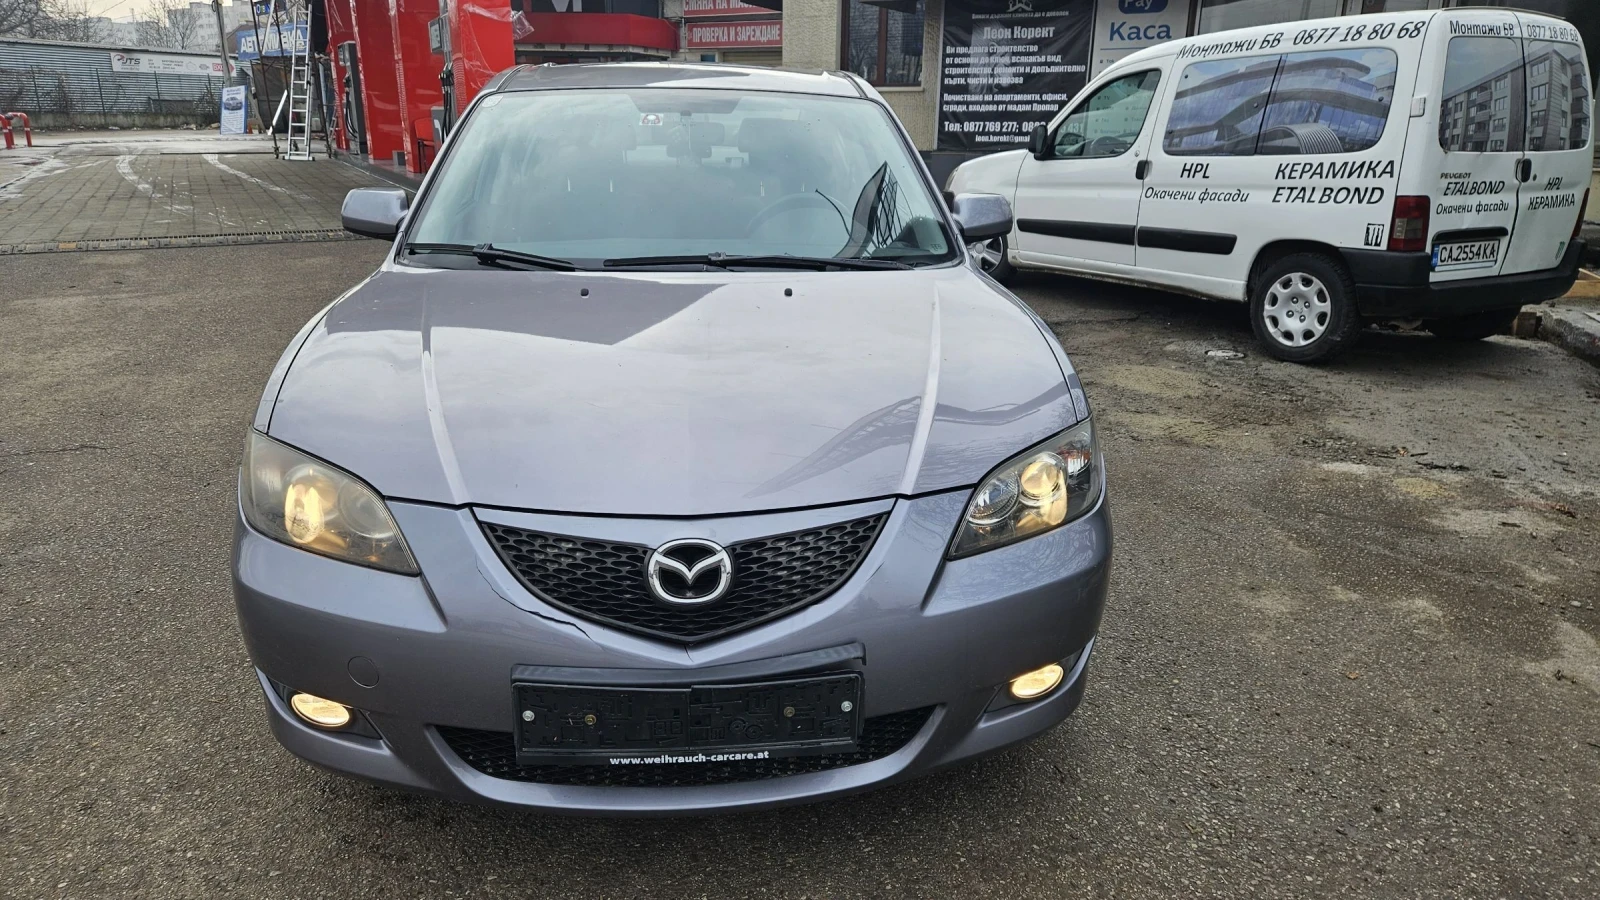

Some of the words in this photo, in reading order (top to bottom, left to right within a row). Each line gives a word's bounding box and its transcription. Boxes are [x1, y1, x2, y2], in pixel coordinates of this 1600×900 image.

[684, 0, 714, 11] СМЯНА
[692, 26, 728, 43] ПРОВЕРКА
[730, 27, 735, 42] И
[737, 25, 780, 42] ЗАРЕЖДАНЕ
[983, 26, 1012, 39] Леон
[1014, 26, 1055, 39] Корект
[1109, 21, 1172, 41] Каса
[1450, 20, 1500, 36] Монтажи
[1503, 22, 1514, 36] БВ
[1526, 24, 1546, 39] 0877
[1548, 26, 1558, 40] 18
[1559, 28, 1569, 41] 80
[1569, 29, 1579, 42] 68
[1177, 38, 1258, 60] Монтажи
[1259, 32, 1285, 49] БВ
[1292, 26, 1341, 46] 0877
[1339, 24, 1367, 43] 18
[1367, 22, 1396, 41] 80
[1397, 20, 1426, 39] 68
[946, 46, 955, 54] Ви
[956, 46, 988, 54] предлага
[990, 45, 1038, 53] строителство
[954, 56, 978, 64] основи
[980, 56, 989, 64] до
[1012, 55, 1045, 63] всякакъв
[1047, 55, 1061, 63] вид
[994, 66, 1024, 74] ремонти
[1031, 65, 1086, 74] допълнително
[994, 76, 1023, 85] извозва
[944, 93, 983, 101] Почистване
[1042, 93, 1068, 101] офиси,
[969, 104, 997, 112] входове
[1007, 103, 1031, 112] мадам
[1032, 103, 1059, 112] Пропар
[944, 121, 962, 132] Тел:
[963, 121, 983, 132] 0877
[985, 121, 1001, 132] 769
[1002, 121, 1019, 133] 277;
[1179, 163, 1211, 179] HPL
[1275, 160, 1395, 180] КЕРАМИКА
[1443, 181, 1505, 196] ETALBOND
[1544, 176, 1563, 191] HPL
[1144, 186, 1196, 201] Окачени
[1198, 188, 1250, 204] фасади
[1271, 187, 1385, 204] ETALBOND
[1528, 193, 1575, 210] КЕРАМИКА
[1436, 203, 1473, 215] Окачени
[1475, 200, 1509, 215] фасади
[609, 750, 770, 764] www.weihrauch-carcare.at
